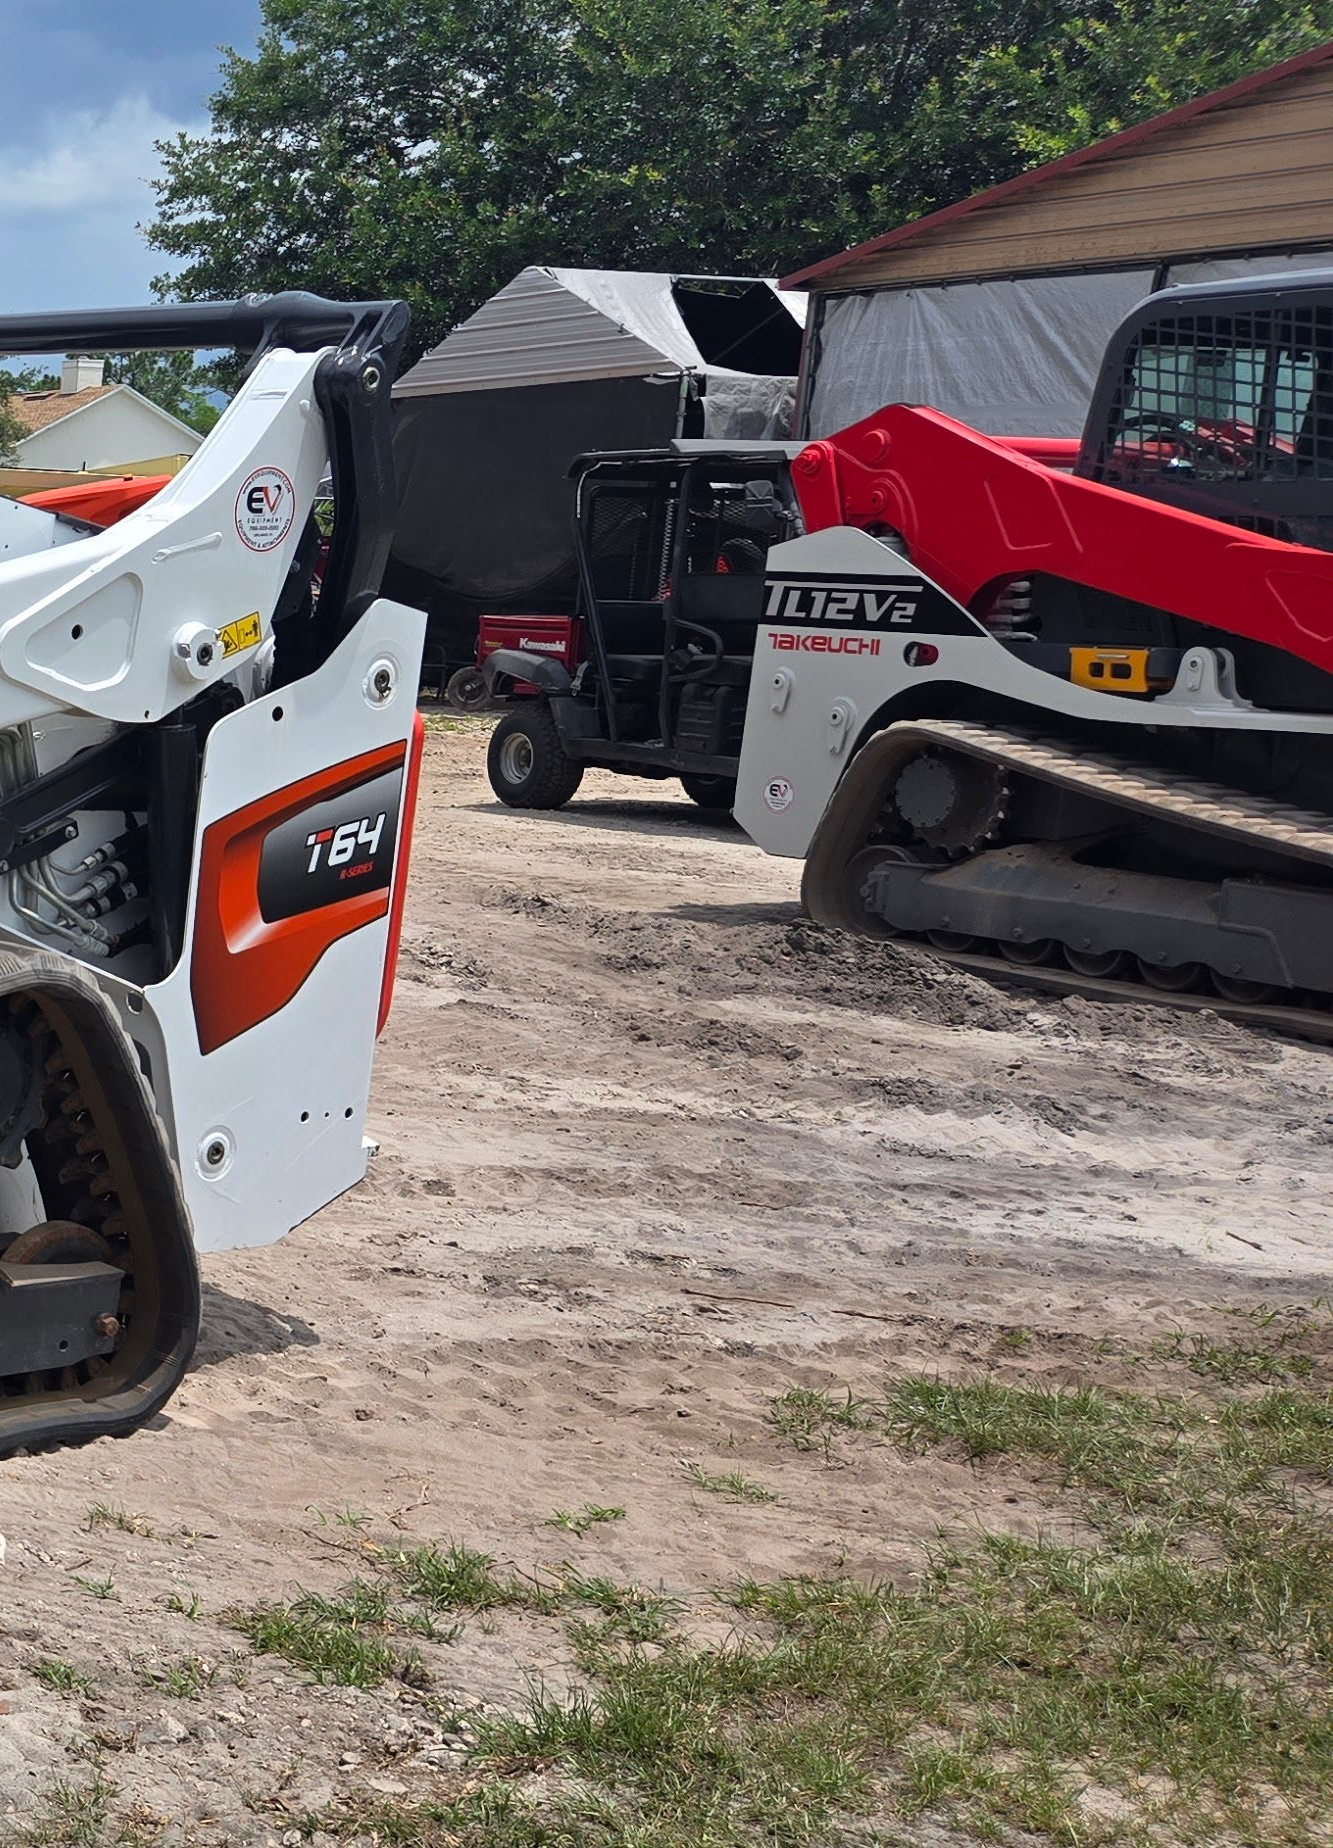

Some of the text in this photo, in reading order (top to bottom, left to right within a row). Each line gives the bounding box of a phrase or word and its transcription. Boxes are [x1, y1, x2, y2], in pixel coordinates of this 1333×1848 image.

[247, 484, 283, 514] EV
[519, 637, 566, 652] Kawasaki
[769, 783, 788, 798] EV
[306, 813, 386, 873] T64
